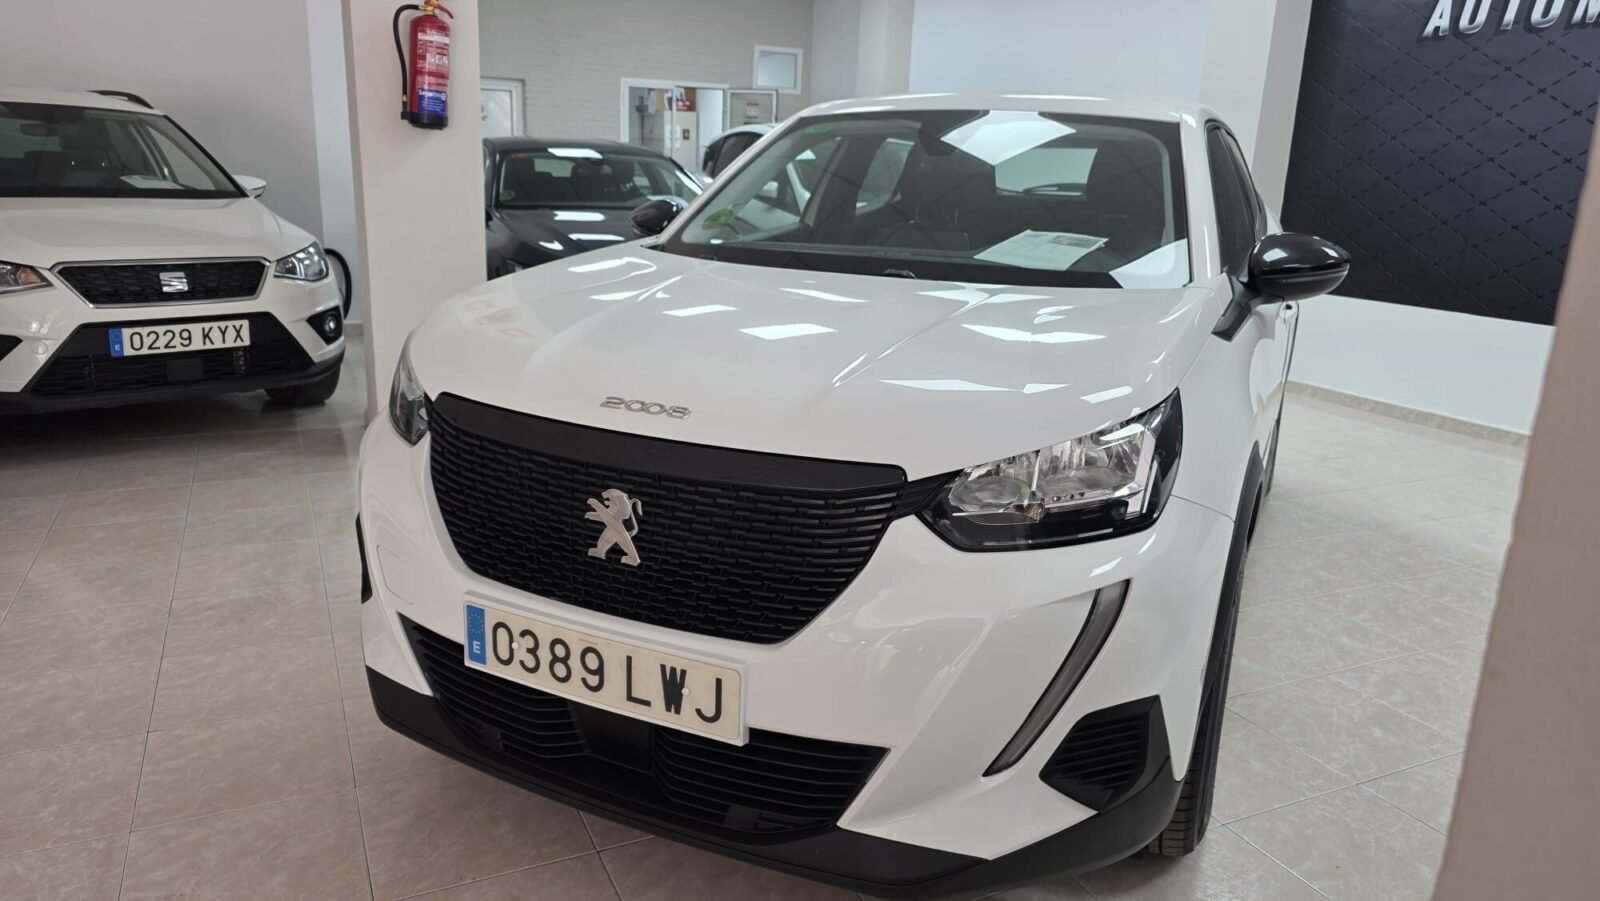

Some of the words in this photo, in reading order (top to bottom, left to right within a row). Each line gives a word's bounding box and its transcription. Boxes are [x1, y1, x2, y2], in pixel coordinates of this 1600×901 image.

[129, 328, 192, 351] 0229
[201, 324, 245, 346] KYX
[600, 396, 691, 419] 2008
[472, 640, 481, 654] E
[492, 621, 605, 693] 0389
[625, 655, 723, 724] LWJ
